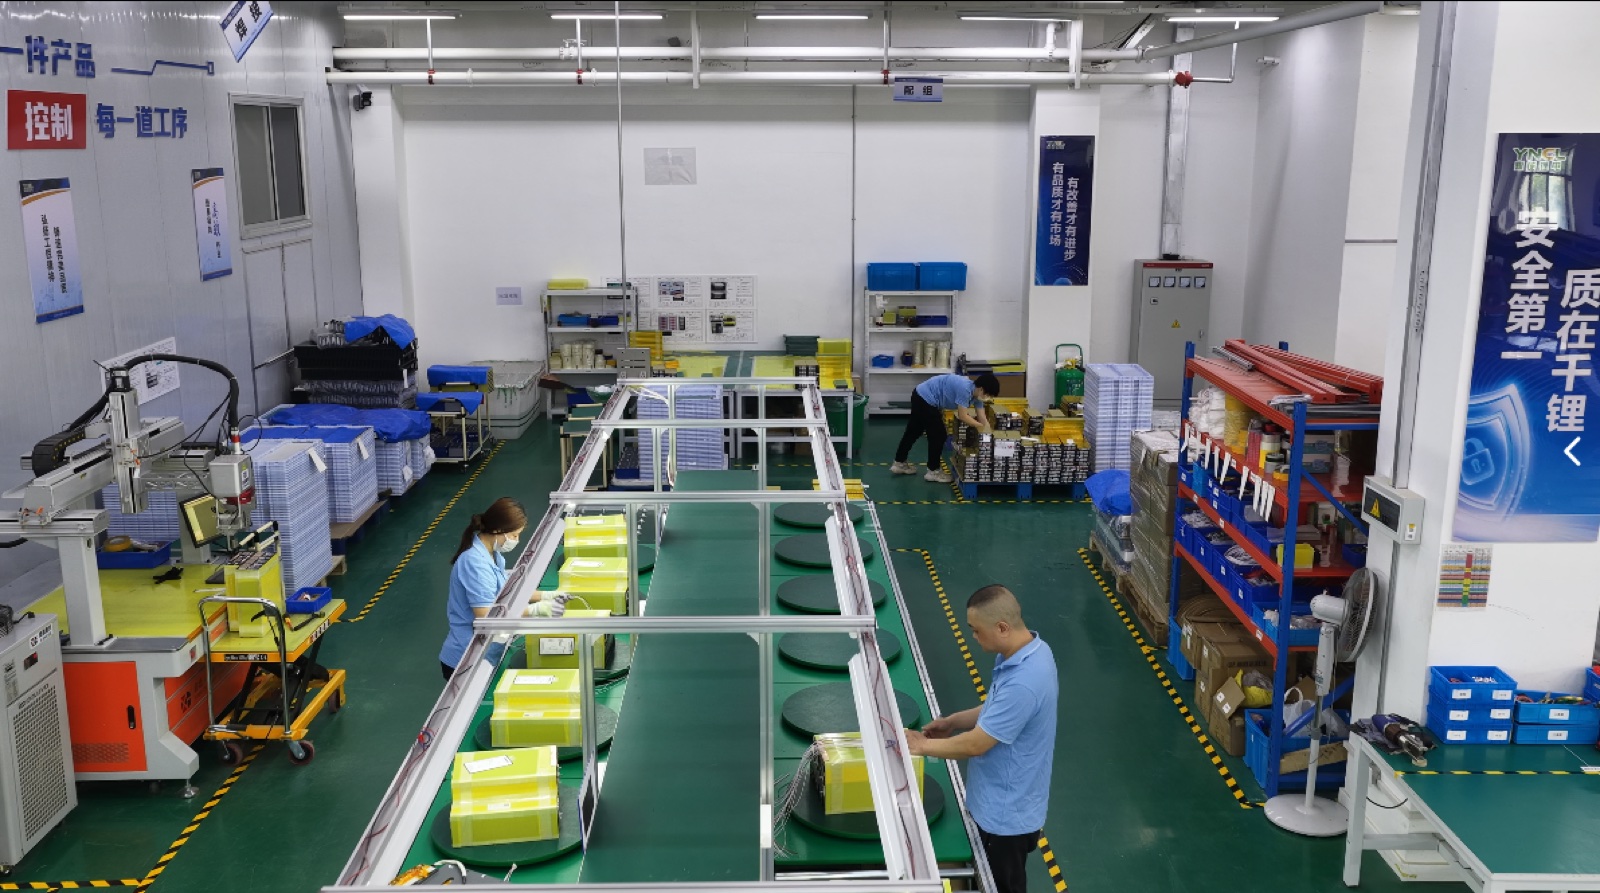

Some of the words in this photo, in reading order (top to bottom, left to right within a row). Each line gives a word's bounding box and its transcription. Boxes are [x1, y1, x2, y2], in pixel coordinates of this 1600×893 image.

[0, 35, 96, 78] 一件产品
[25, 101, 74, 142] 控制
[96, 103, 188, 139] 每一道工序
[1049, 162, 1065, 247] 有品质才有市场
[1063, 176, 1080, 261] 有改善才有进步
[1501, 205, 1559, 360] 安全第一
[1545, 268, 1600, 432] 质在千锂
